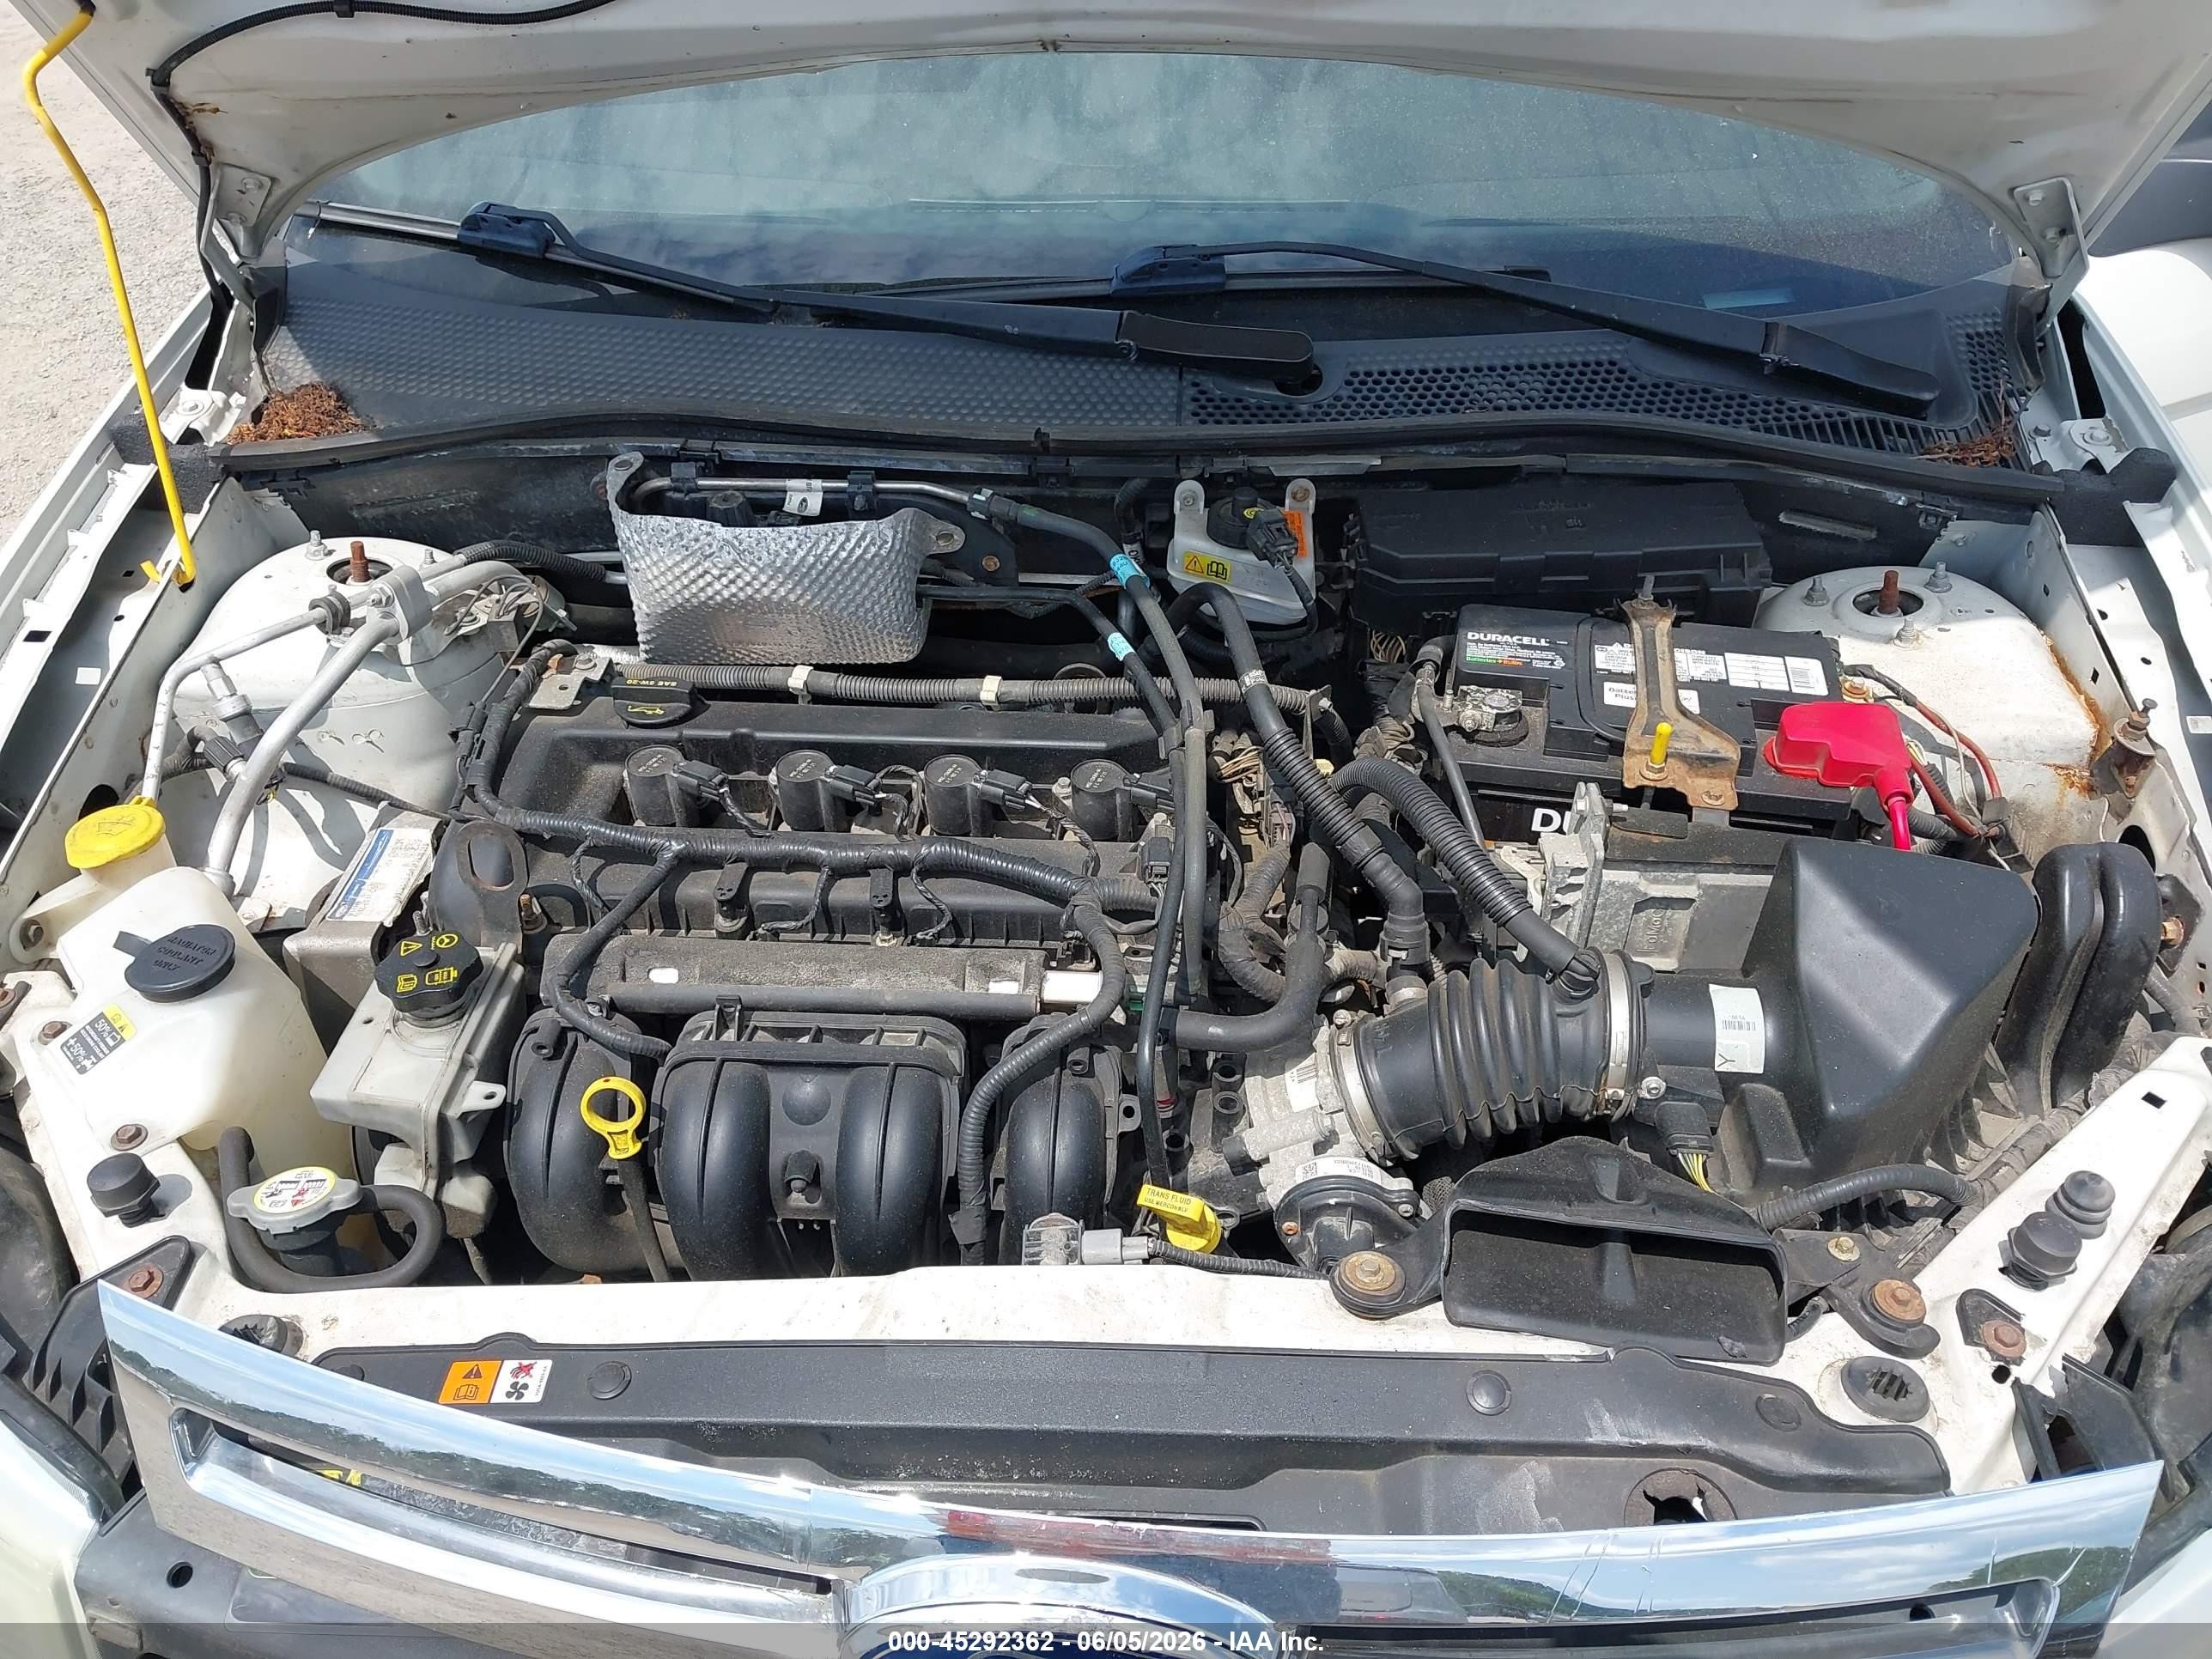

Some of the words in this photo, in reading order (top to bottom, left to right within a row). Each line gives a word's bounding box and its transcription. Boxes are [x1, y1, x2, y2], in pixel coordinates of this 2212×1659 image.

[1467, 631, 1550, 647] DURACELL
[94, 1018, 112, 1037] 50%
[1144, 1196, 1155, 1206] USE
[1147, 1188, 1169, 1200] TRANS
[1171, 1194, 1192, 1206] FLUID
